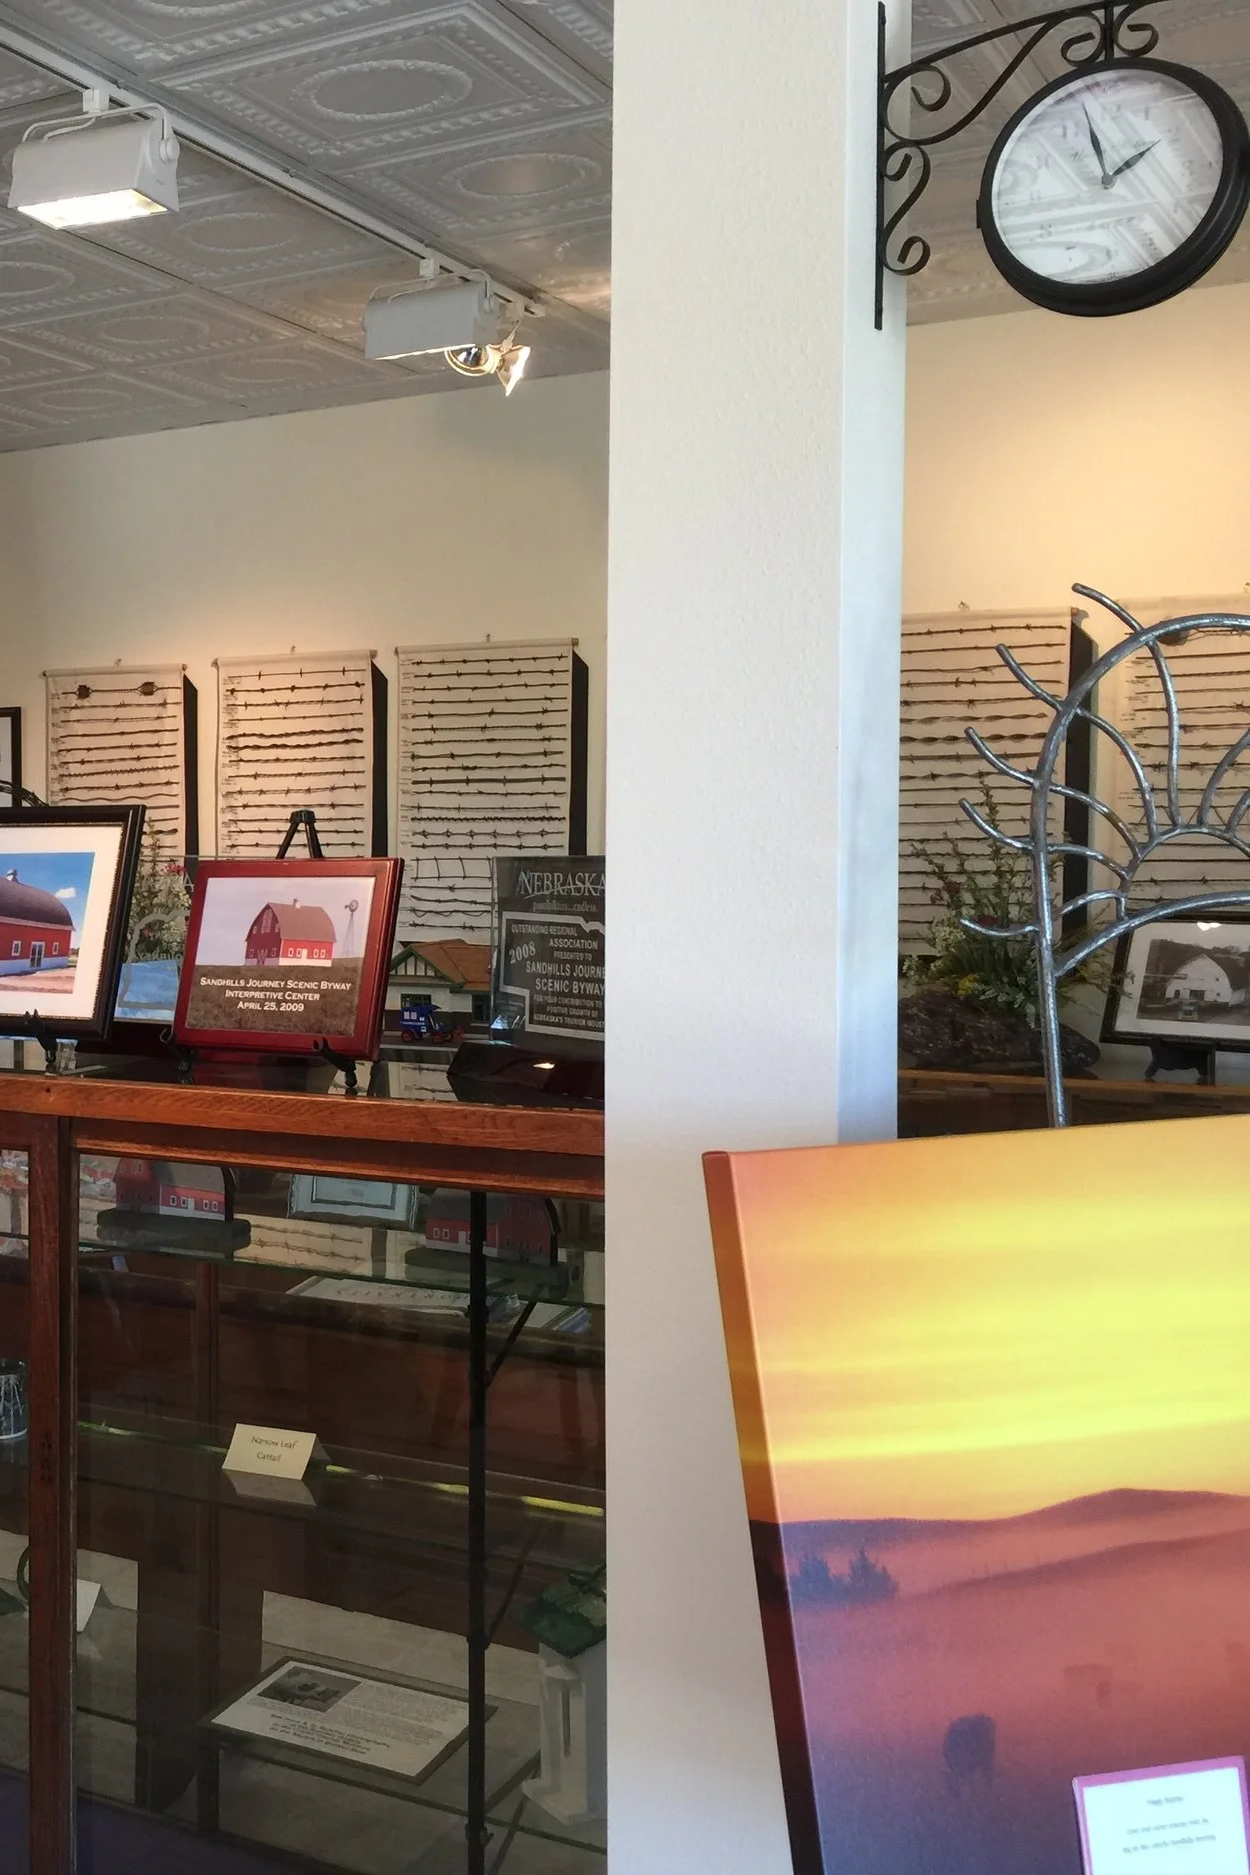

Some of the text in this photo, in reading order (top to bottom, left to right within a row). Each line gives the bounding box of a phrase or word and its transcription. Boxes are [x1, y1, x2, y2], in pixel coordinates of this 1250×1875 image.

[515, 872, 606, 897] NEBRASKA
[549, 937, 598, 950] ASSOCIATION
[508, 941, 536, 964] 2008
[553, 951, 584, 961] PRESENTED
[526, 960, 606, 980] SANDHILLS JOURNE
[200, 977, 352, 991] SANDHILLS JOURNEY SCENIC BYWAY
[535, 978, 606, 996] SCENIC BYWAY
[225, 989, 321, 1001] INTERPRETIVE CENTER
[237, 1001, 306, 1012] APRIL 25, 2009
[252, 1436, 298, 1449] Narrow Leaf
[256, 1451, 282, 1462] Cattail
